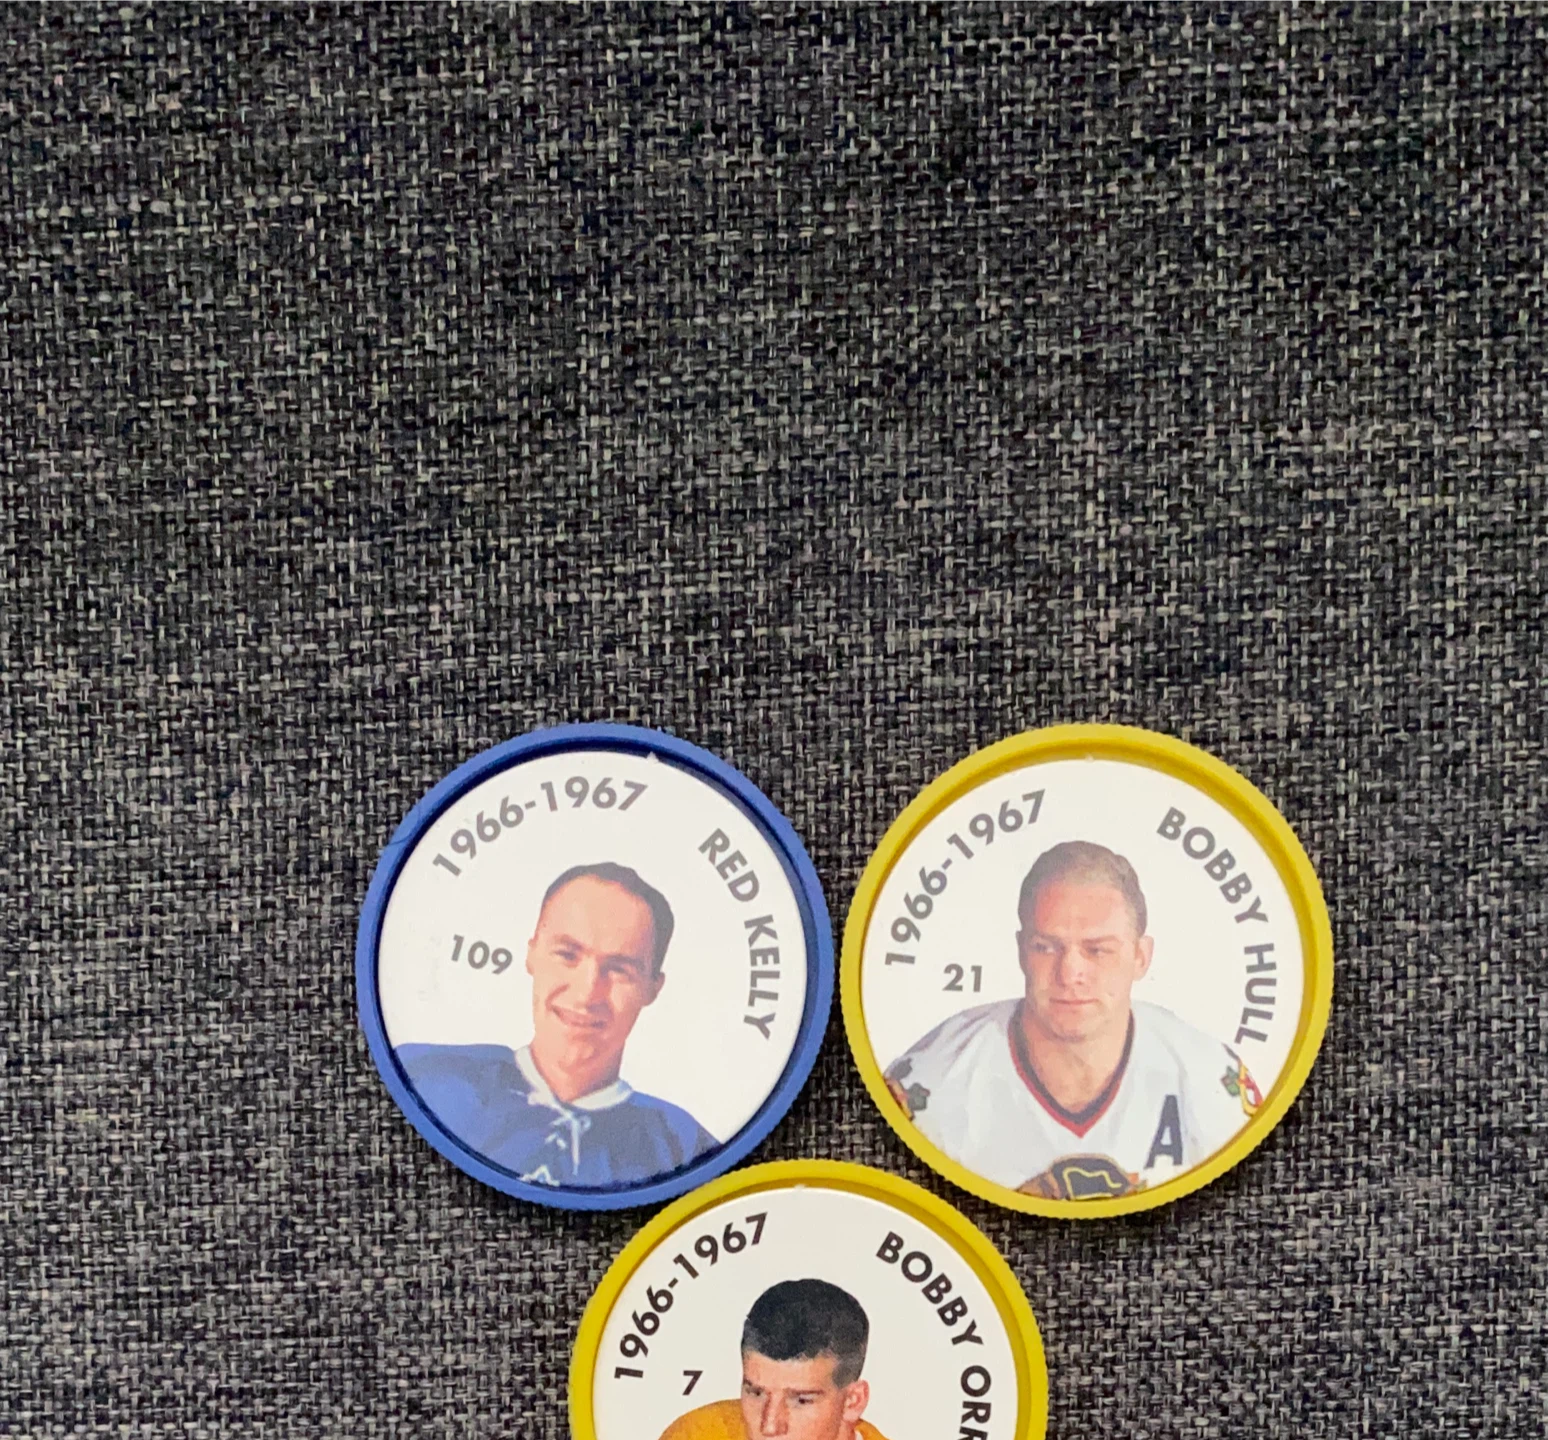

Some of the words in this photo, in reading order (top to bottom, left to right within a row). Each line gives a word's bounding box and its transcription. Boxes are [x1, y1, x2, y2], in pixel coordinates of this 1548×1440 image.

[432, 776, 648, 877] 1966-1967
[885, 789, 1045, 966] 1966-1967
[450, 934, 513, 974] 109
[698, 828, 760, 902] RED
[743, 914, 781, 1039] KELLY
[942, 964, 982, 992] 21
[1156, 807, 1269, 925] BOBBY
[1234, 942, 1277, 1045] HULL
[614, 1212, 768, 1379] 1966-1967
[875, 1231, 984, 1348] BOBBY
[682, 1370, 703, 1396] 7
